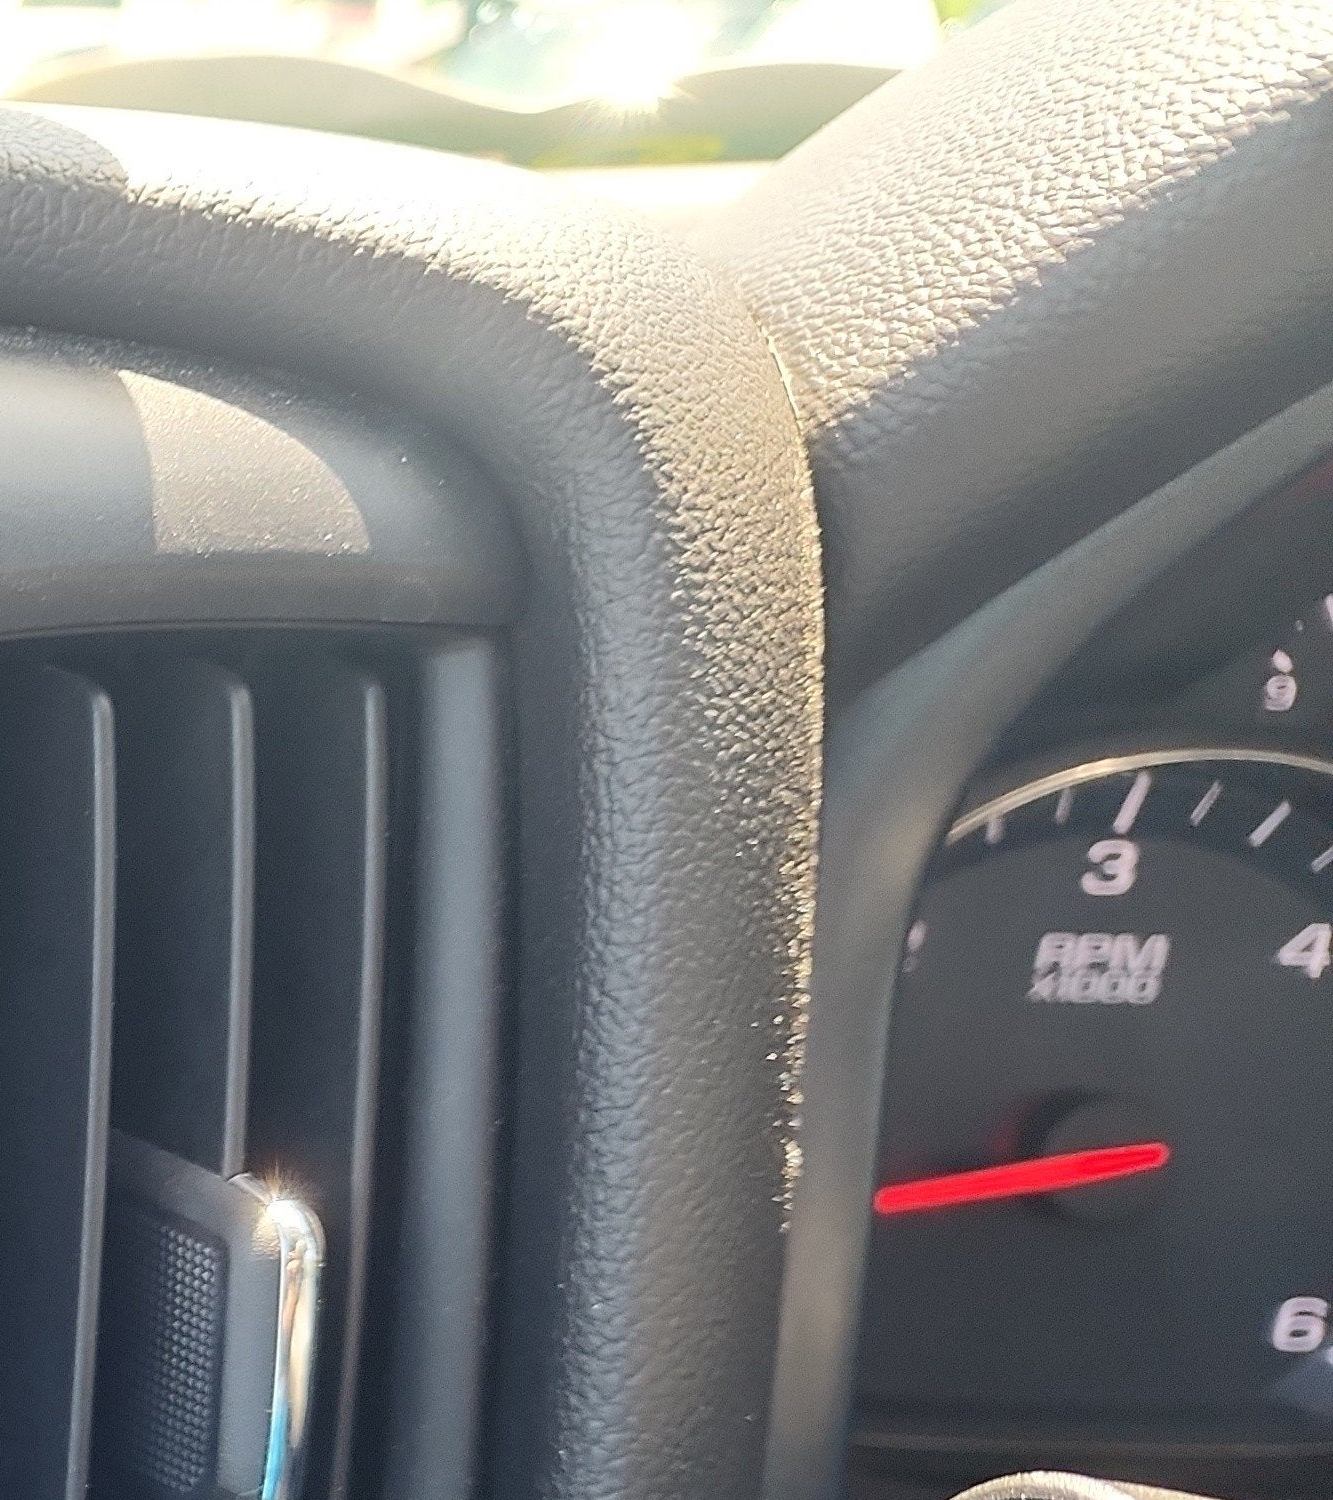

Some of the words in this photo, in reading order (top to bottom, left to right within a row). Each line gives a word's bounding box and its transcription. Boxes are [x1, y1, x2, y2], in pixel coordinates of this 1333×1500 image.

[1081, 838, 1139, 897] 3
[1034, 930, 1171, 973] RPM
[1277, 922, 1332, 979] 4
[1271, 1296, 1328, 1352] 6
